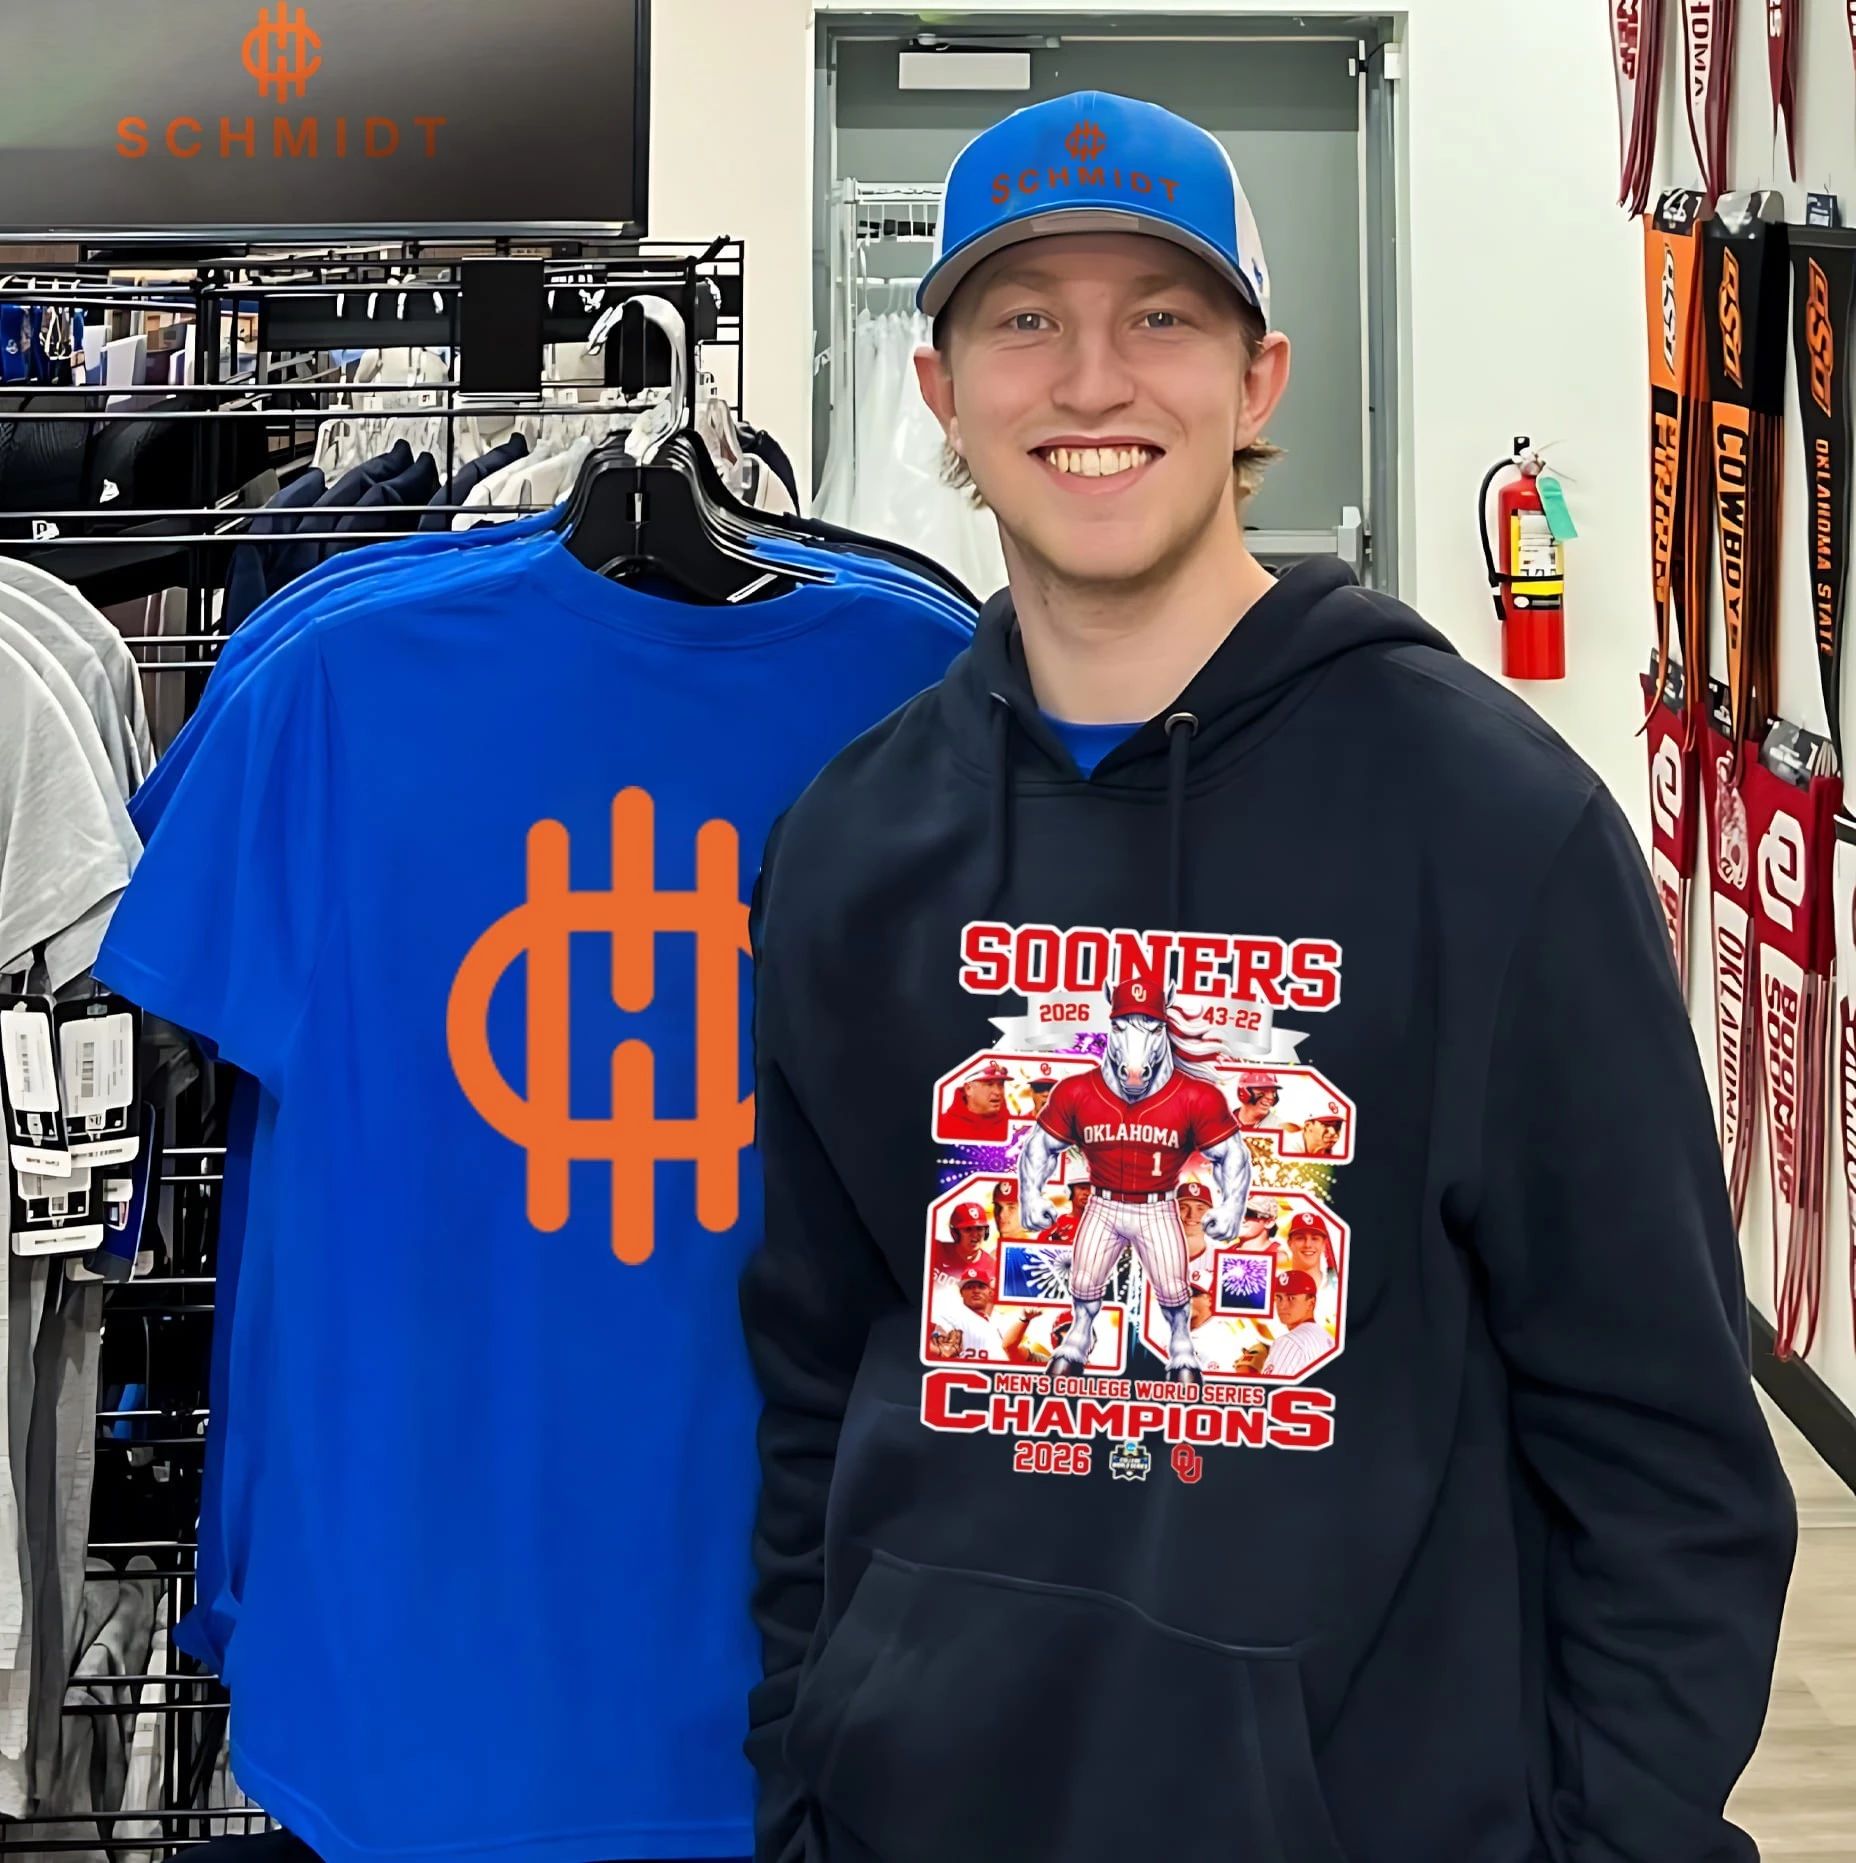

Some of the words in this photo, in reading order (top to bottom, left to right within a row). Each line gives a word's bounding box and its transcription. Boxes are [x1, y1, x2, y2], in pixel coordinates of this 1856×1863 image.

[115, 115, 449, 159] SCHMIDT
[991, 166, 1181, 206] SCHMIDT
[959, 921, 1342, 1012] SOONERS
[1040, 1003, 1090, 1022] 2026
[1202, 1006, 1262, 1030] 43-22
[1083, 1122, 1180, 1149] OKLAHOMA
[1151, 1152, 1162, 1177] 1
[994, 1375, 1051, 1394] MEN'S
[1055, 1377, 1130, 1398] COLLEGE
[1134, 1382, 1199, 1401] WORLD
[1203, 1385, 1265, 1405] SERIES
[920, 1370, 1336, 1450] CHAMPIONS
[1013, 1441, 1092, 1475] 2026
